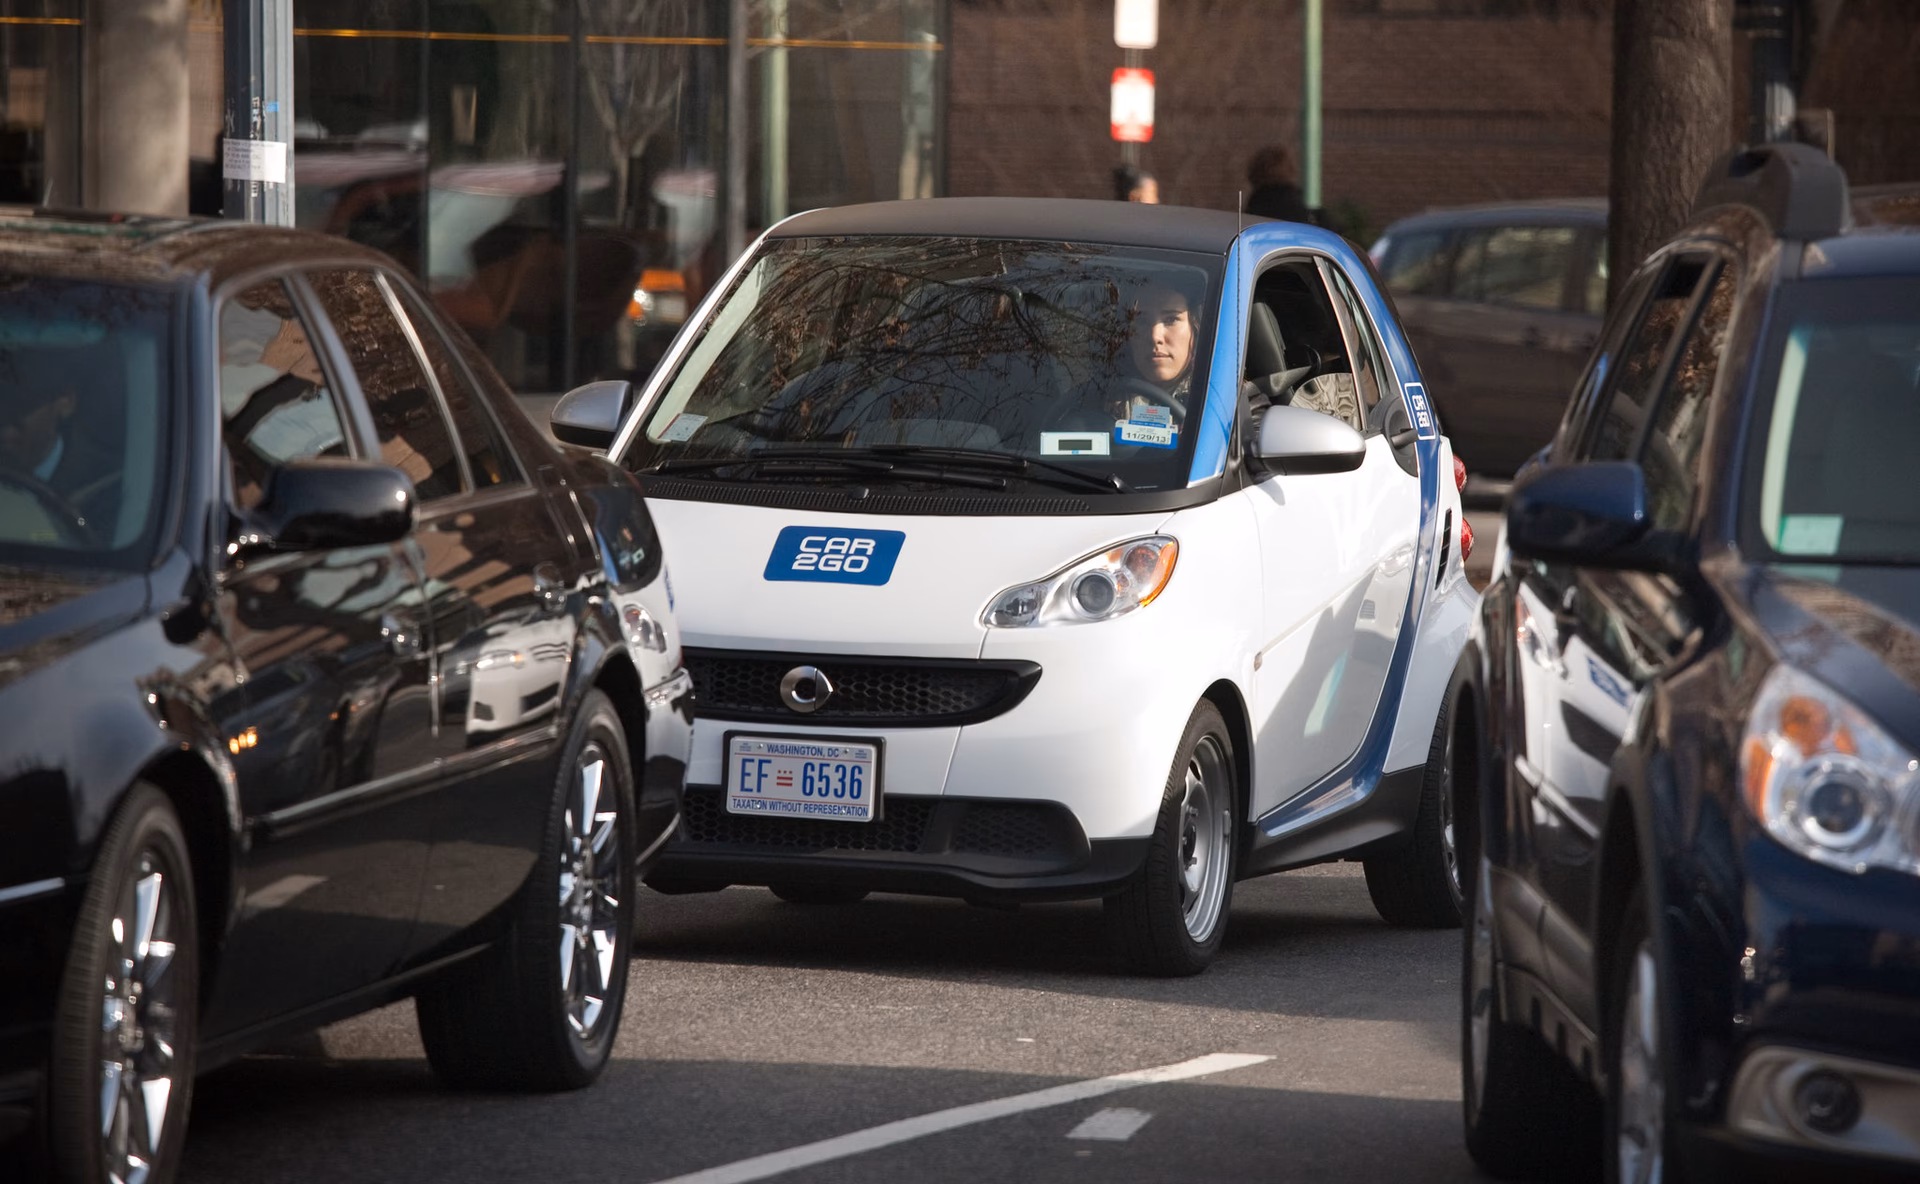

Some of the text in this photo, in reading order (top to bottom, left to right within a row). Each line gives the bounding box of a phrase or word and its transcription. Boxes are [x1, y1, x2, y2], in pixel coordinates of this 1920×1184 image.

[1126, 432, 1167, 443] 11/29/13
[799, 536, 876, 556] CAR
[791, 553, 869, 573] 2GO
[766, 744, 826, 758] WASHINGTON,
[827, 748, 840, 758] DC
[740, 758, 863, 799] EF 6536
[733, 798, 869, 817] TAXATION WITHOUT REPRESENTATION
